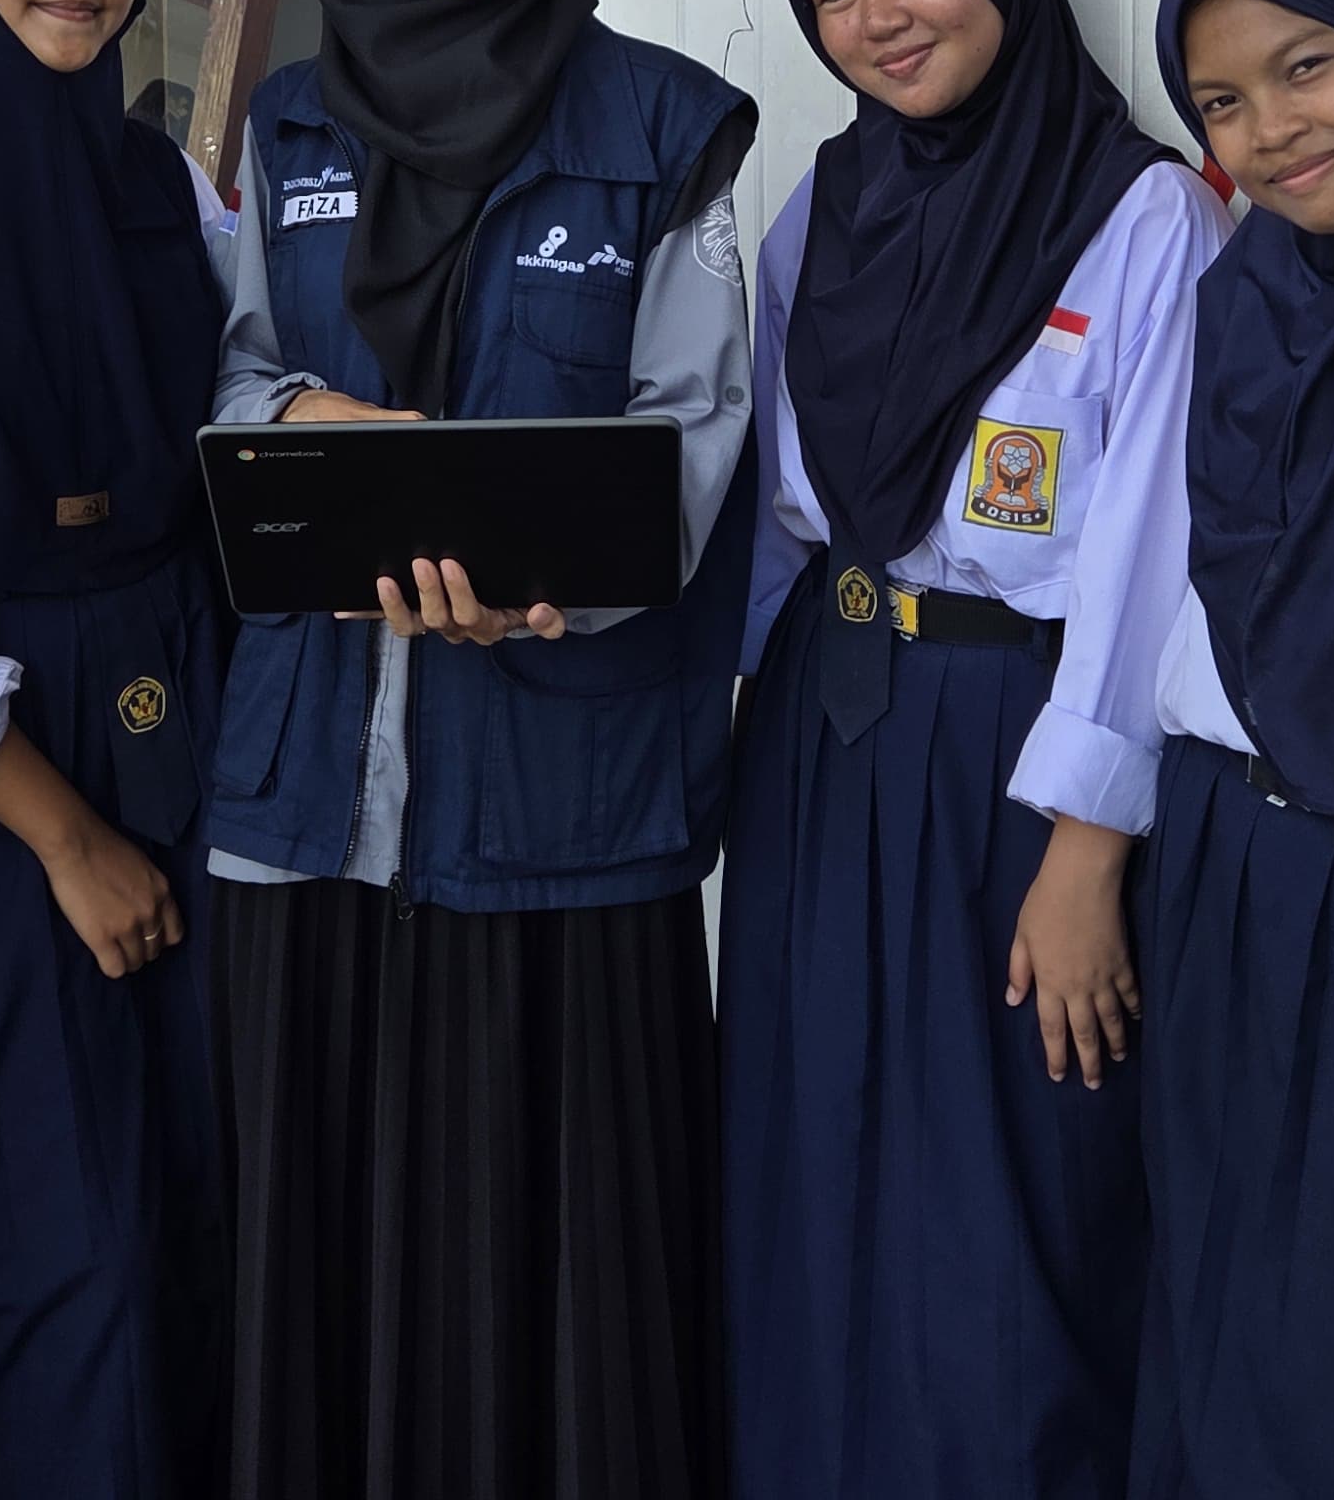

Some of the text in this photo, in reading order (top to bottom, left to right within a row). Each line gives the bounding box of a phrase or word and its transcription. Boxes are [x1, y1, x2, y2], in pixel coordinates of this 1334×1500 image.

[297, 195, 340, 219] FAZA
[516, 254, 586, 274] skkmigas
[987, 506, 1033, 523] OSIS
[252, 522, 309, 533] acer
